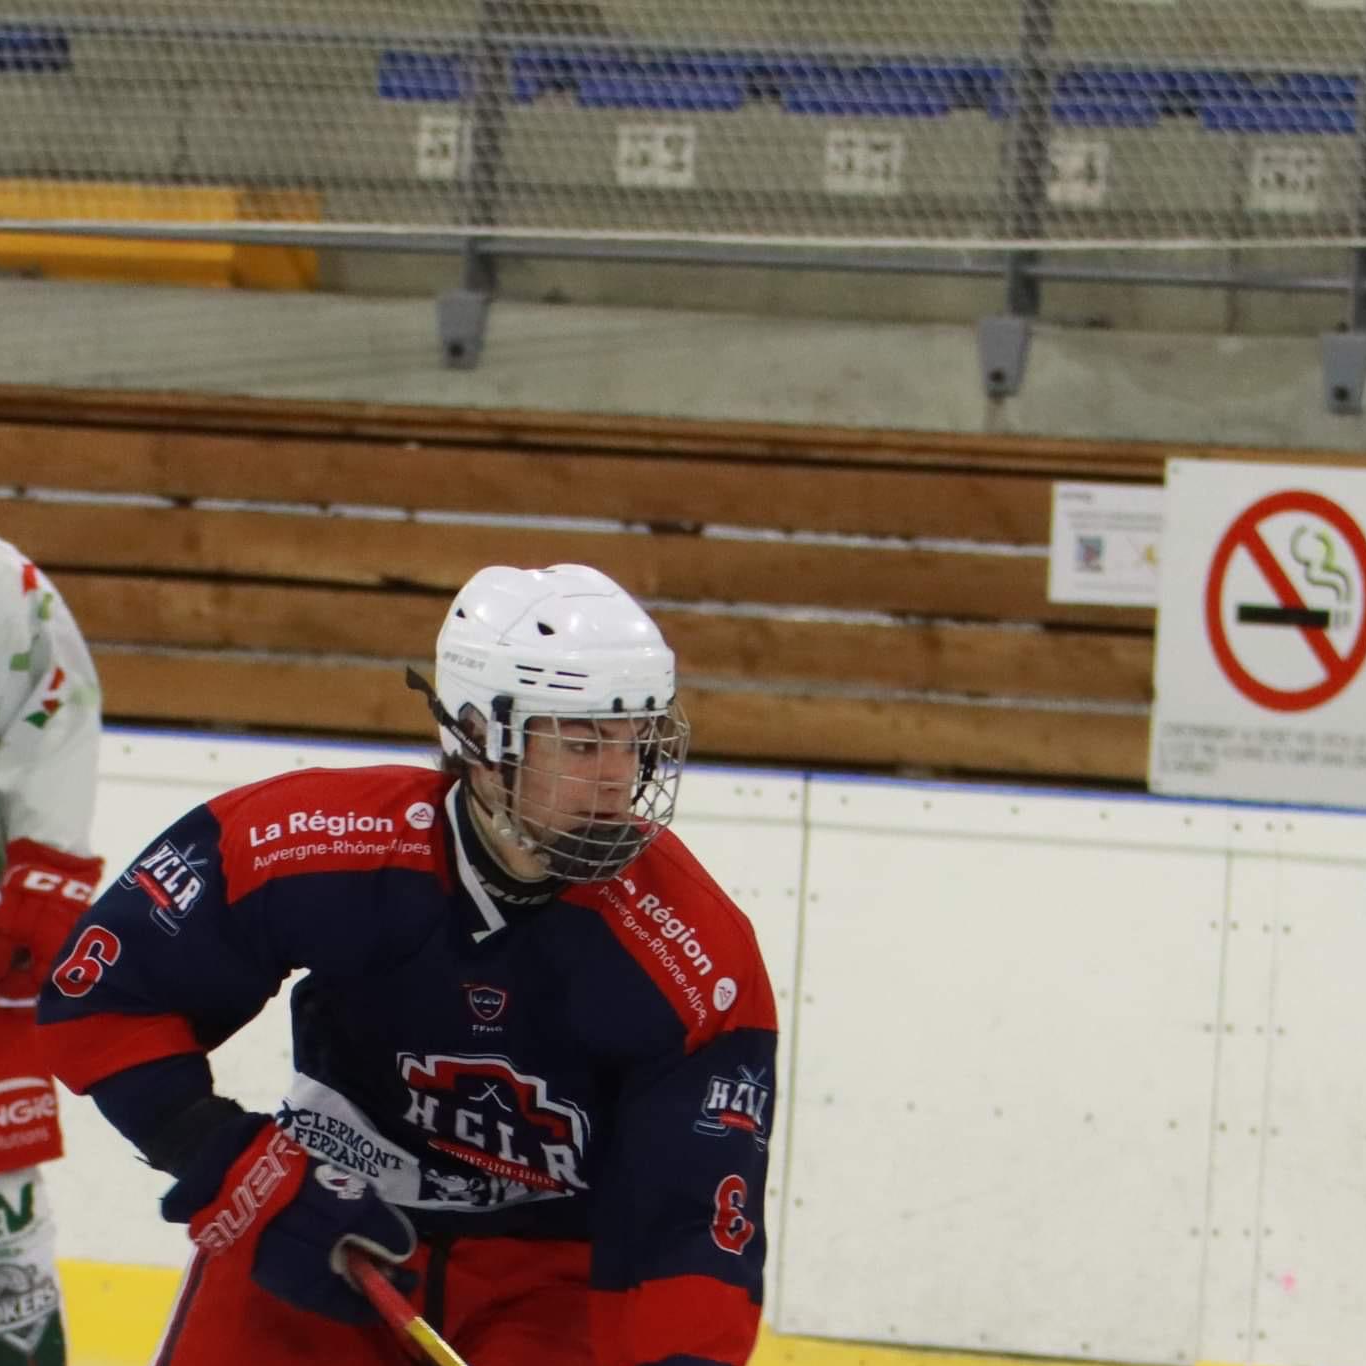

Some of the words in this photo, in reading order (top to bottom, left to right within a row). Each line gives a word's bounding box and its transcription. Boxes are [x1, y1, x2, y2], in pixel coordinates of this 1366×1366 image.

[249, 822, 282, 848] La
[288, 810, 394, 837] Région
[51, 925, 122, 998] 6
[635, 893, 713, 976] Région
[295, 1108, 404, 1171] CLERMONT
[402, 1087, 590, 1190] HCLR
[710, 1174, 756, 1256] 6
